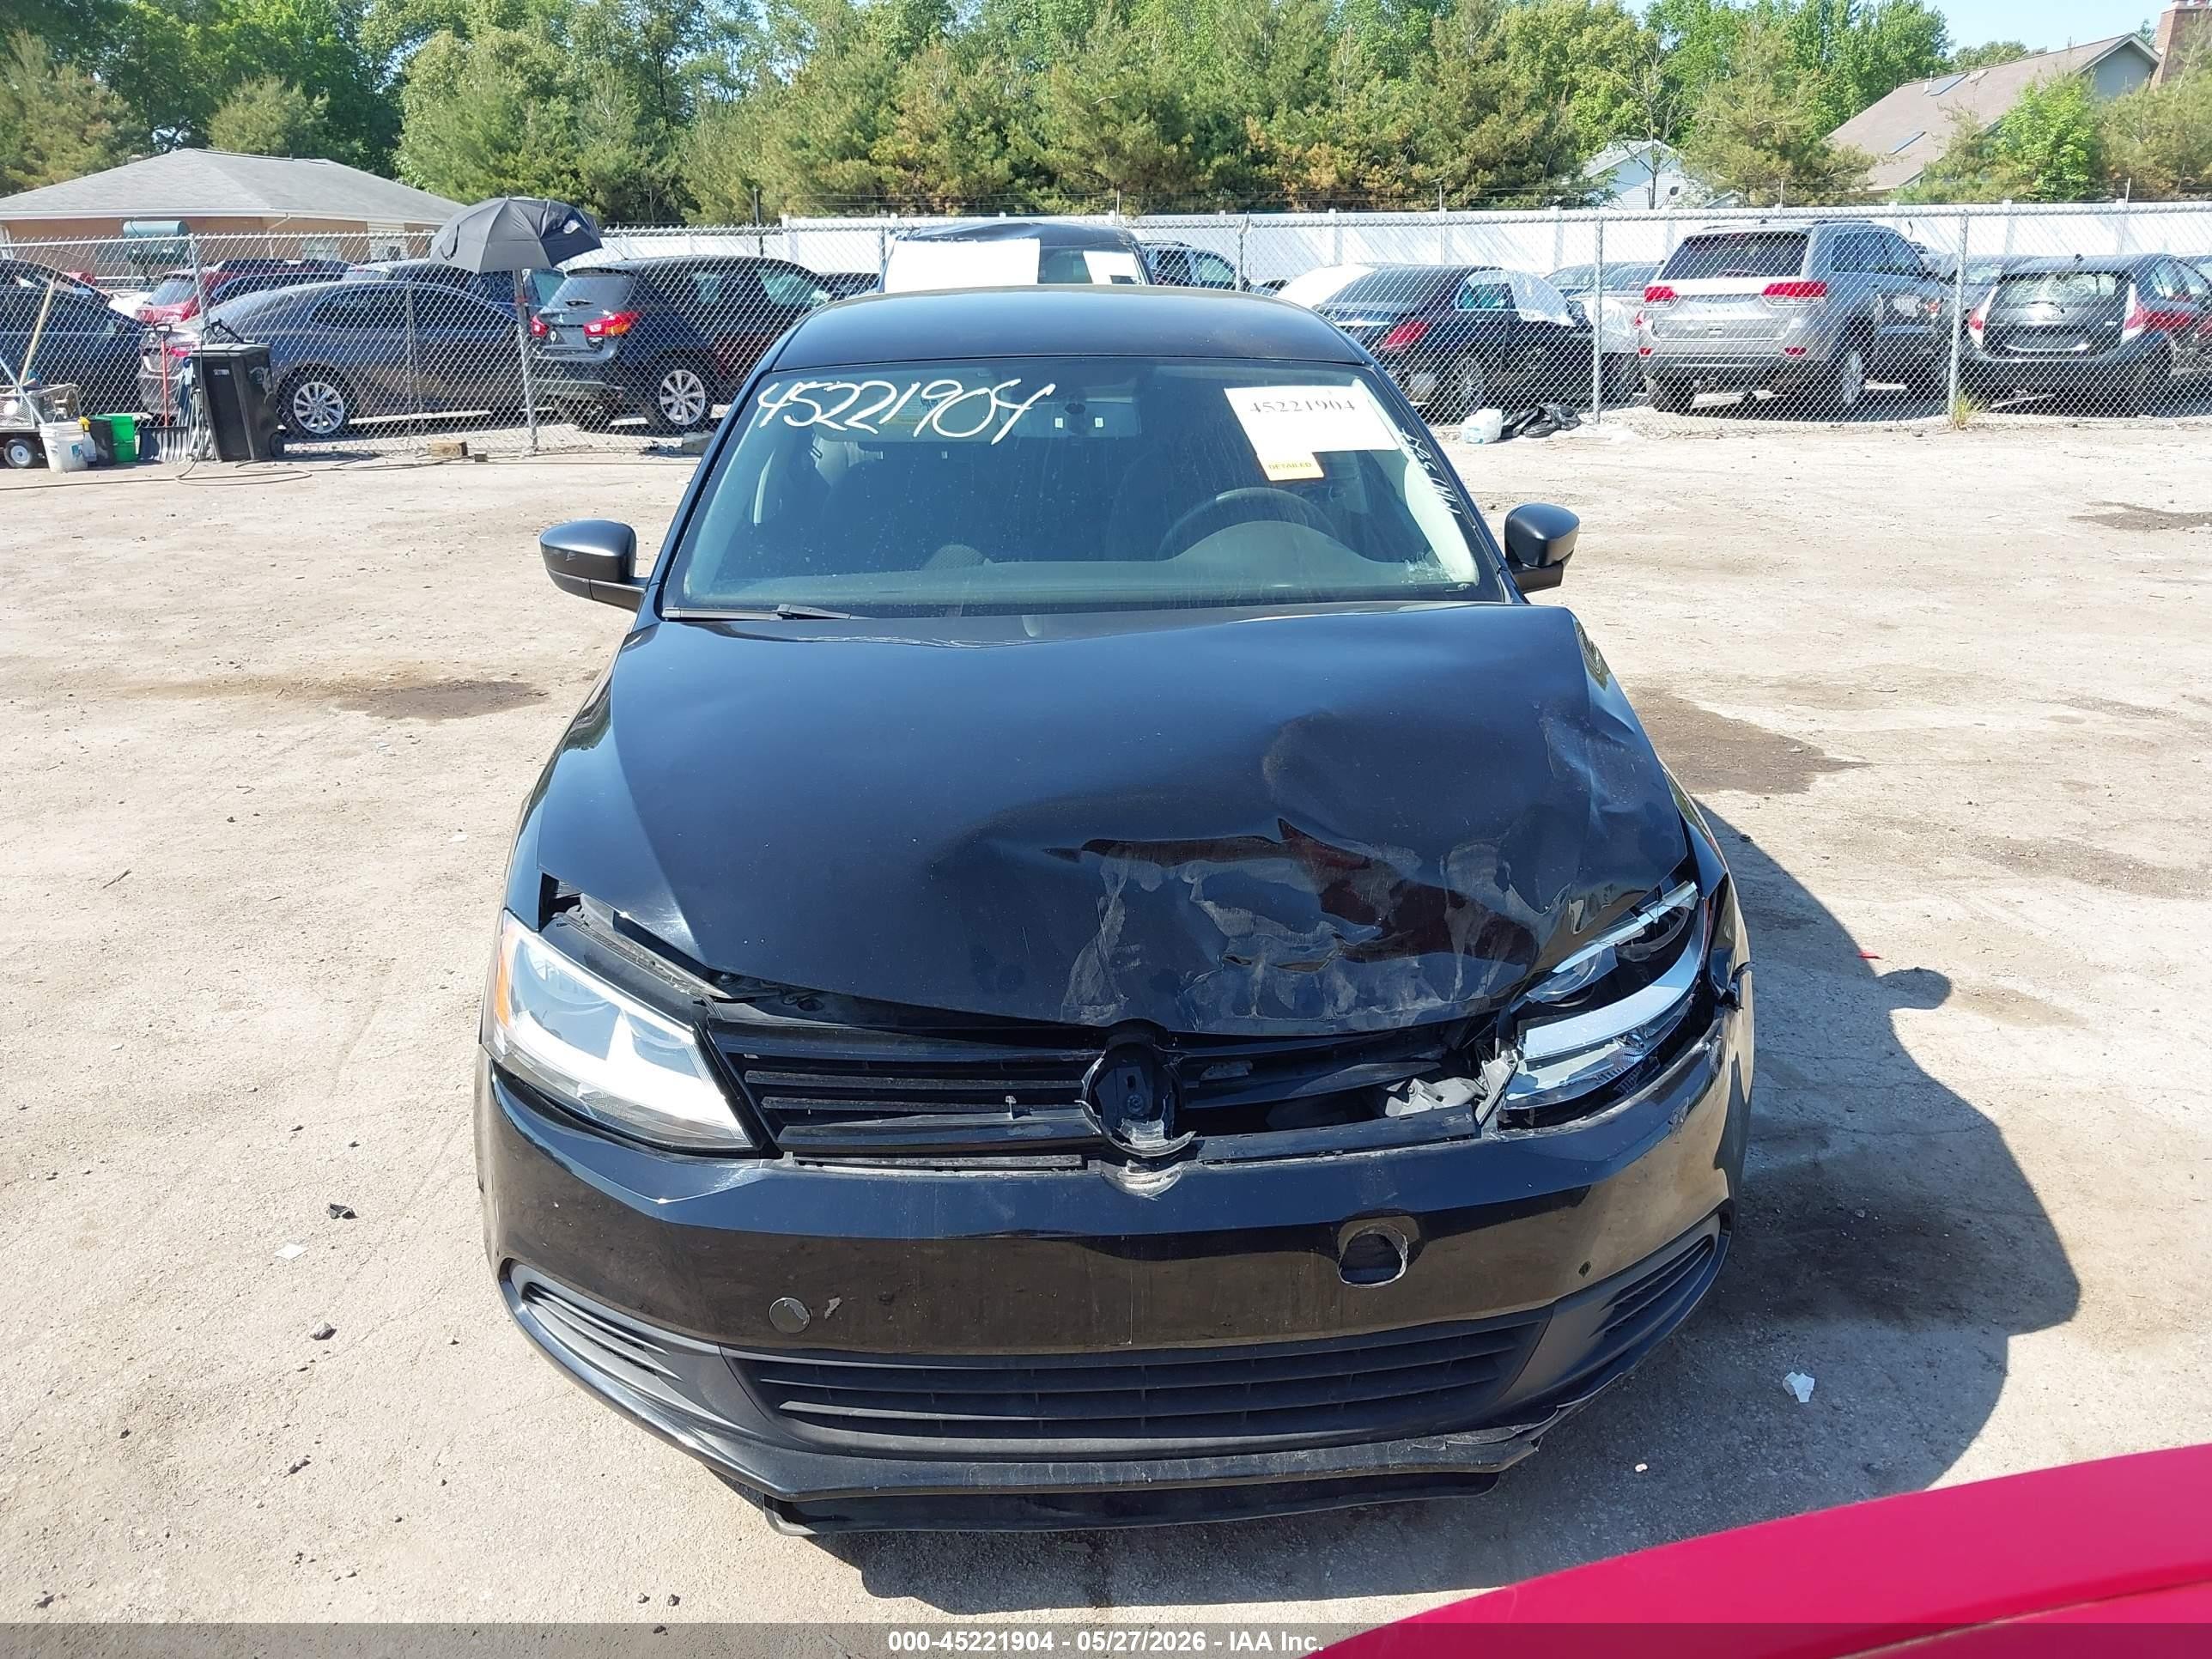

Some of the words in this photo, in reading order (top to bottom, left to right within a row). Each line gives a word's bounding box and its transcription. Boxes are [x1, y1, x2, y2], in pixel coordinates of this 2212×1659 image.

[757, 378, 1056, 446] 45221904
[1249, 398, 1356, 414] 45221904
[1268, 461, 1313, 471] DETAILED
